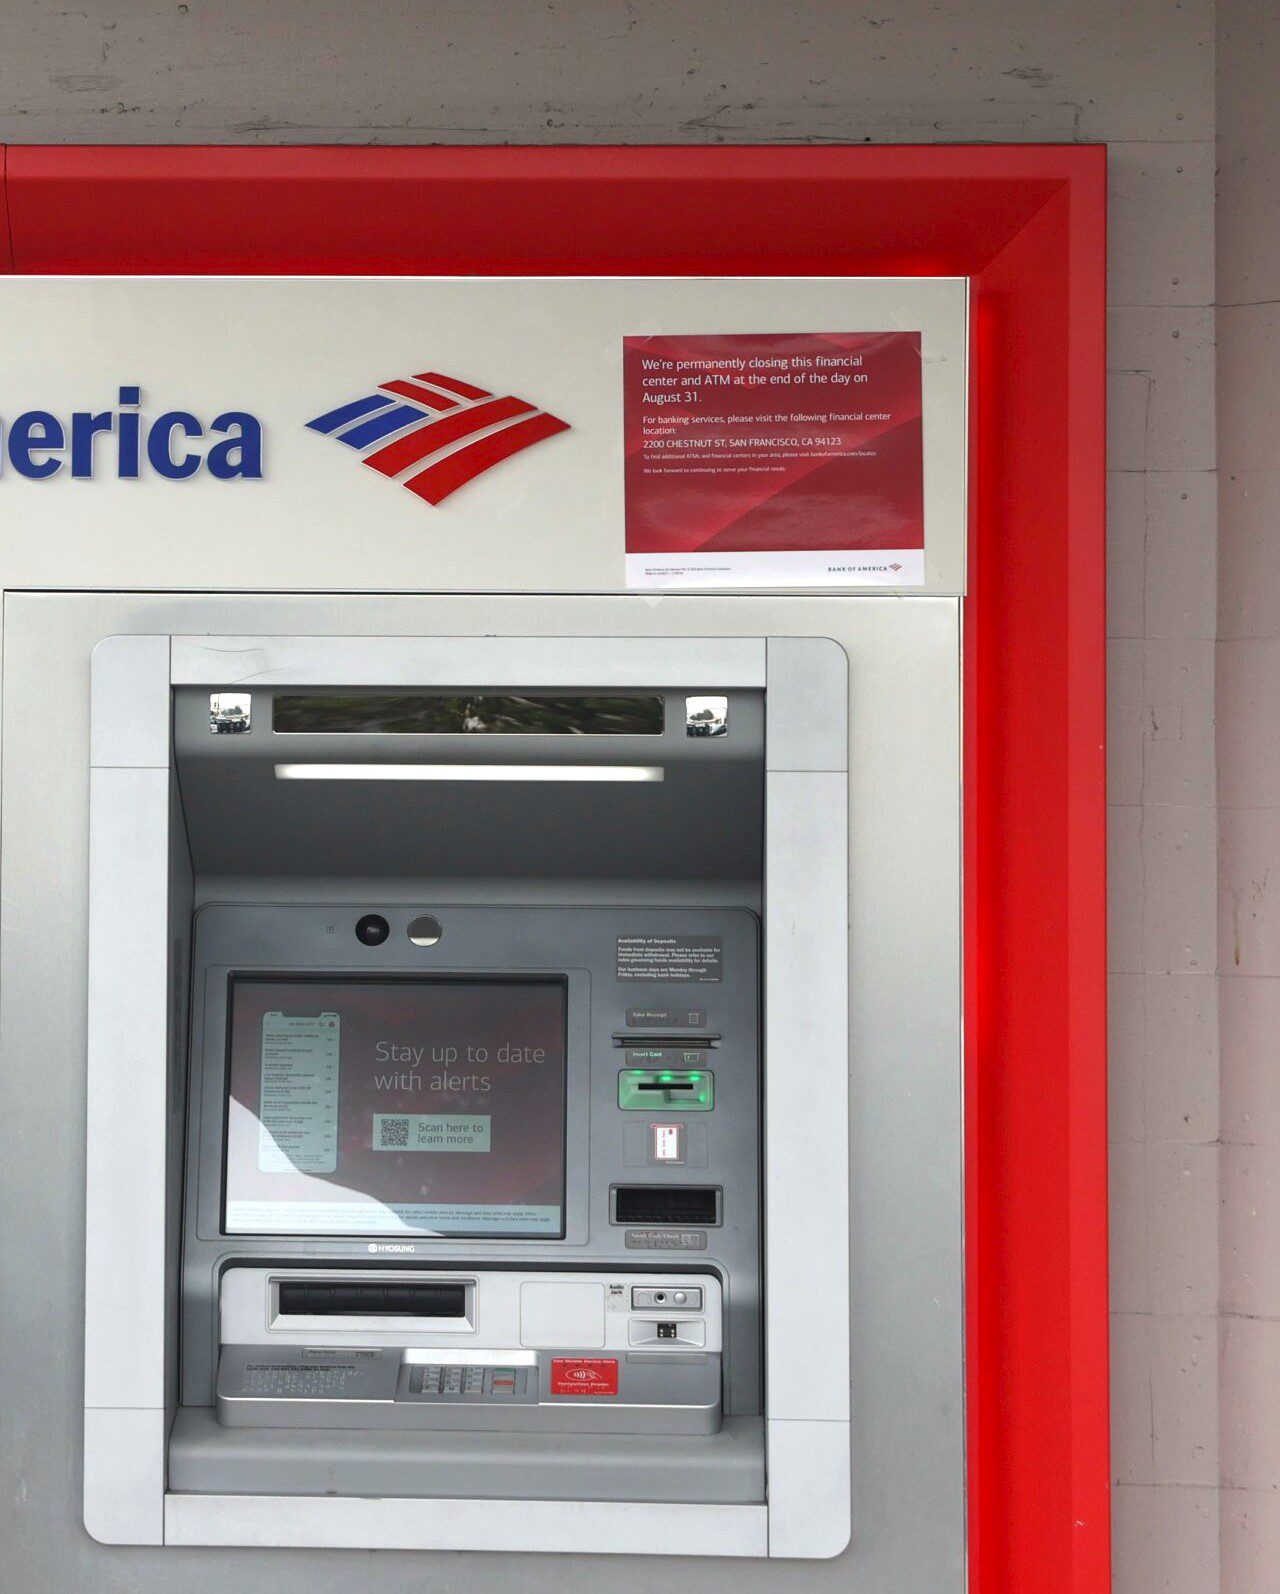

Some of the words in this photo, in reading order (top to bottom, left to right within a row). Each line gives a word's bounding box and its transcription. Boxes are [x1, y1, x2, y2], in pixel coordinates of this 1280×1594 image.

[642, 358, 673, 370] We're
[676, 357, 746, 372] permanently
[748, 356, 788, 371] closing
[791, 356, 813, 368] this
[816, 355, 863, 367] financial
[642, 377, 678, 387] center
[681, 374, 702, 386] and
[704, 374, 731, 386] ATM
[734, 376, 745, 385] at
[748, 373, 767, 385] the
[770, 373, 791, 385] end
[793, 372, 806, 384] of
[809, 372, 828, 384] the
[830, 372, 851, 386] day
[853, 374, 868, 383] on
[642, 392, 681, 406] August
[685, 391, 701, 402] 31.
[643, 415, 656, 424] For
[658, 415, 690, 426] banking
[727, 414, 754, 425] please
[755, 414, 773, 422] visit
[774, 413, 788, 422] the
[790, 413, 827, 424] following
[829, 412, 863, 421] financial
[865, 413, 891, 421] center
[643, 440, 665, 449] 2200
[666, 439, 712, 448] CHESTNUT
[729, 438, 747, 447] SAN
[749, 437, 800, 448] FRANCISCO,
[801, 437, 813, 446] CA
[815, 437, 842, 446] 94123
[375, 1041, 424, 1069] Stay
[432, 1047, 458, 1069] up
[467, 1045, 488, 1063] to
[497, 1042, 545, 1064] date
[374, 1071, 421, 1091] with
[430, 1071, 491, 1091] alerts
[418, 1122, 443, 1133] Scan
[446, 1123, 470, 1133] here
[472, 1124, 484, 1133] to
[417, 1133, 444, 1144] learn
[446, 1134, 474, 1144] more
[378, 1245, 415, 1253] HYOSUNG
